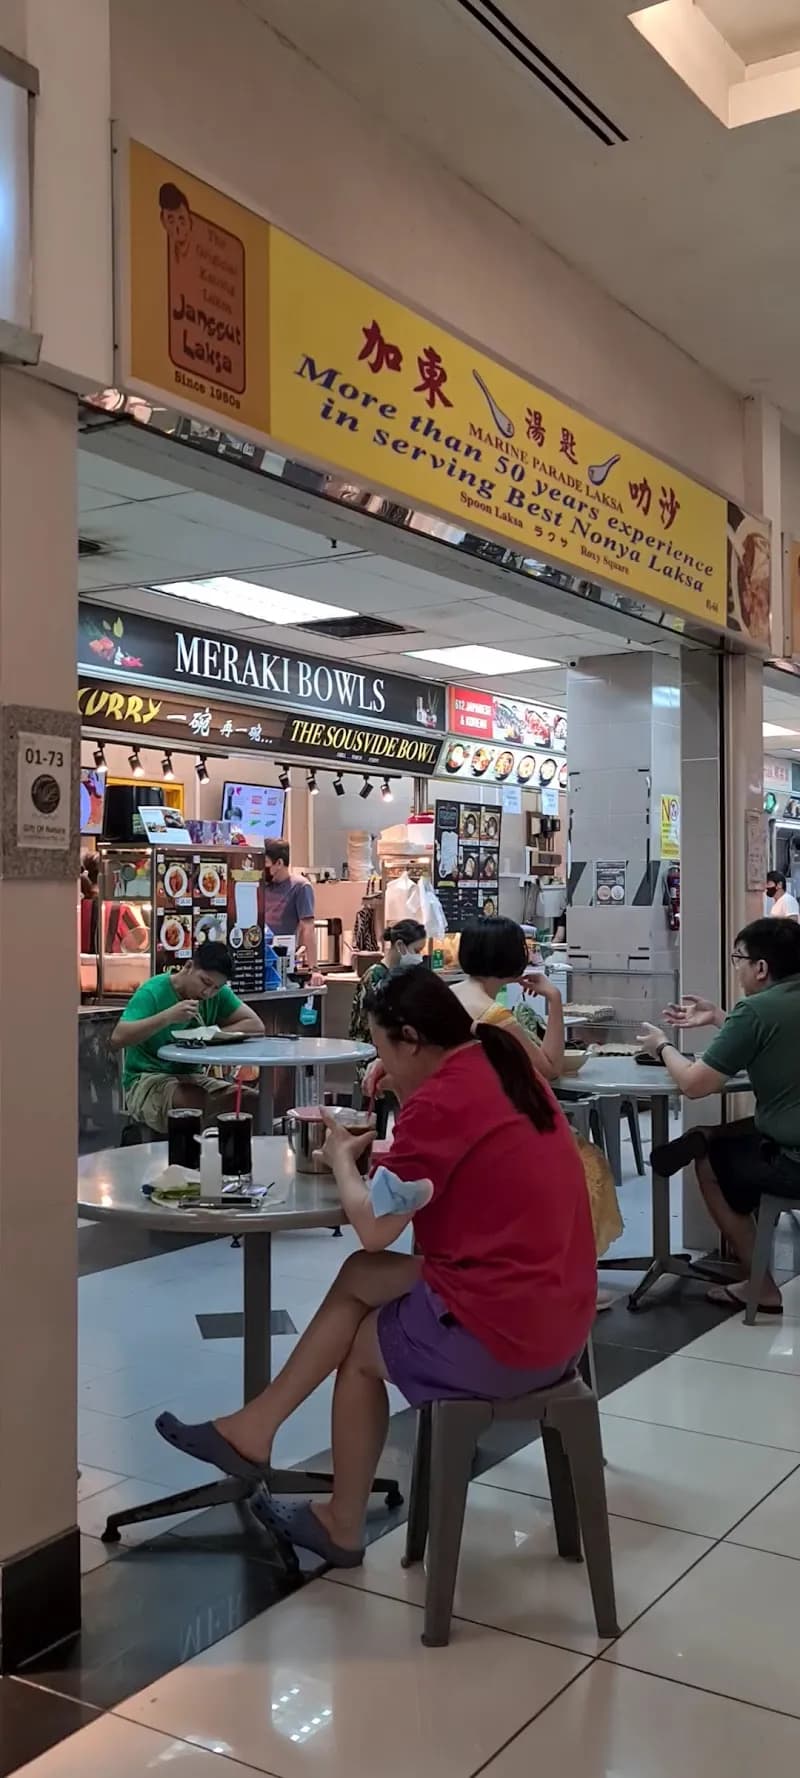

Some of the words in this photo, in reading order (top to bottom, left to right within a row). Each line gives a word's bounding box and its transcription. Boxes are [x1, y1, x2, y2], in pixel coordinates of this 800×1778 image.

[173, 293, 241, 345] Janggut
[183, 329, 233, 374] Laksa
[174, 370, 206, 394] Since
[357, 319, 454, 409] 加東
[525, 407, 579, 465] 湯匙
[628, 477, 681, 530] 叻沙
[293, 353, 398, 420] More
[409, 415, 482, 463] than
[494, 455, 525, 482] 50
[532, 479, 600, 520] years
[607, 516, 714, 577] experience
[468, 422, 529, 465] MARINE
[532, 456, 583, 493] PARADE
[586, 485, 624, 514] LAKSA
[320, 398, 359, 432] in
[372, 428, 496, 500] serving
[505, 485, 563, 527] Best
[569, 516, 641, 563] Nonya
[647, 555, 704, 592] Laksa
[459, 490, 492, 514] Spoon
[494, 506, 524, 528] Laksa
[174, 632, 290, 695] MERAKI
[297, 659, 386, 714] BOWLS
[166, 707, 213, 737] 一碗
[290, 720, 325, 746] THE
[323, 726, 400, 757] SOUSVIDE
[396, 739, 438, 764] BOWL
[25, 748, 64, 767] 01-73
